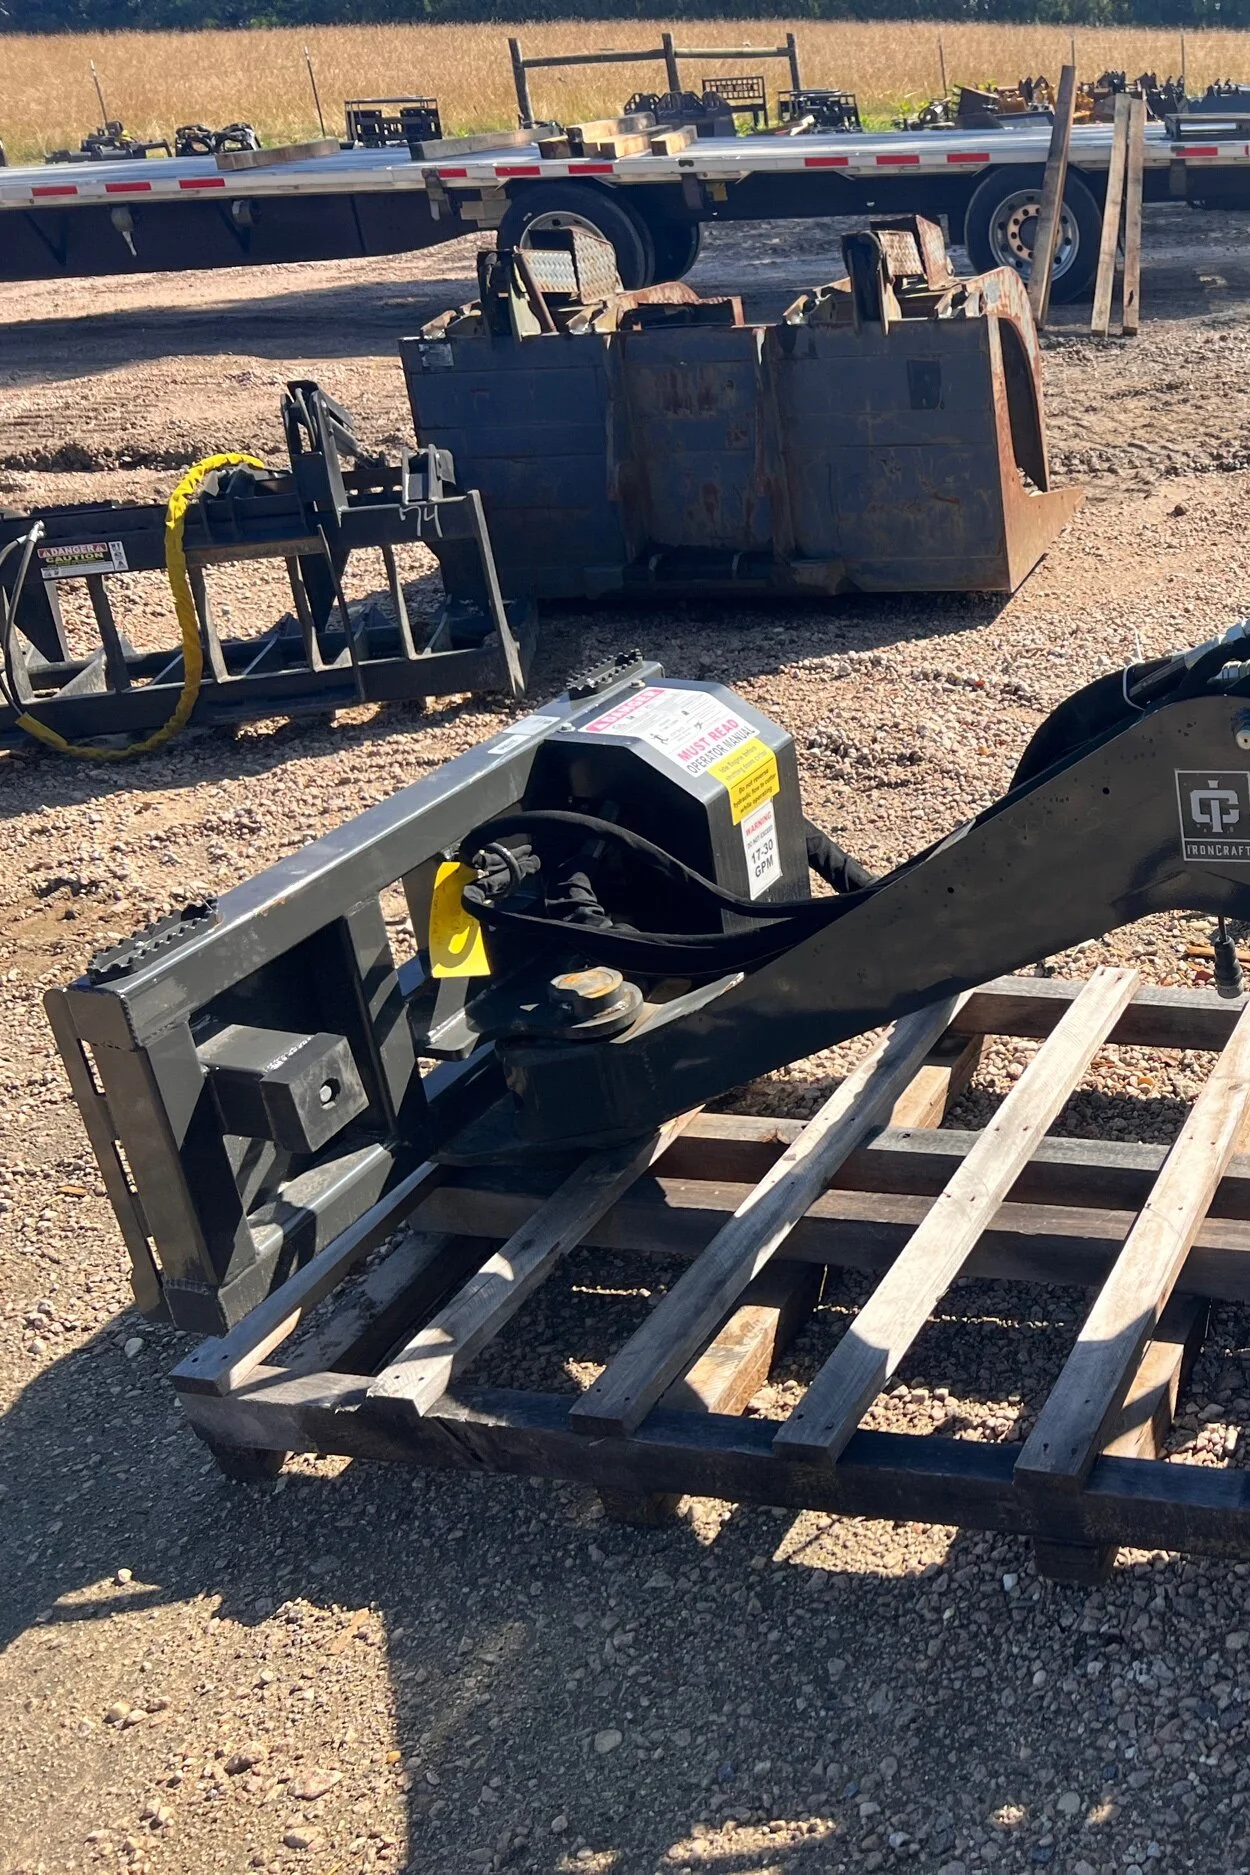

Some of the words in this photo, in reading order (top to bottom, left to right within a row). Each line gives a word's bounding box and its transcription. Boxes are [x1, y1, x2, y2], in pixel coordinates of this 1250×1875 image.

[45, 552, 104, 563] CAUTION
[50, 544, 95, 556] DANGER
[677, 737, 711, 762] MUST
[708, 719, 739, 741] READ
[686, 744, 728, 774] OPERATOR
[722, 725, 756, 749] MANUAL
[745, 811, 772, 836] WARNING
[752, 838, 774, 864] 17-30
[755, 855, 774, 877] GPM
